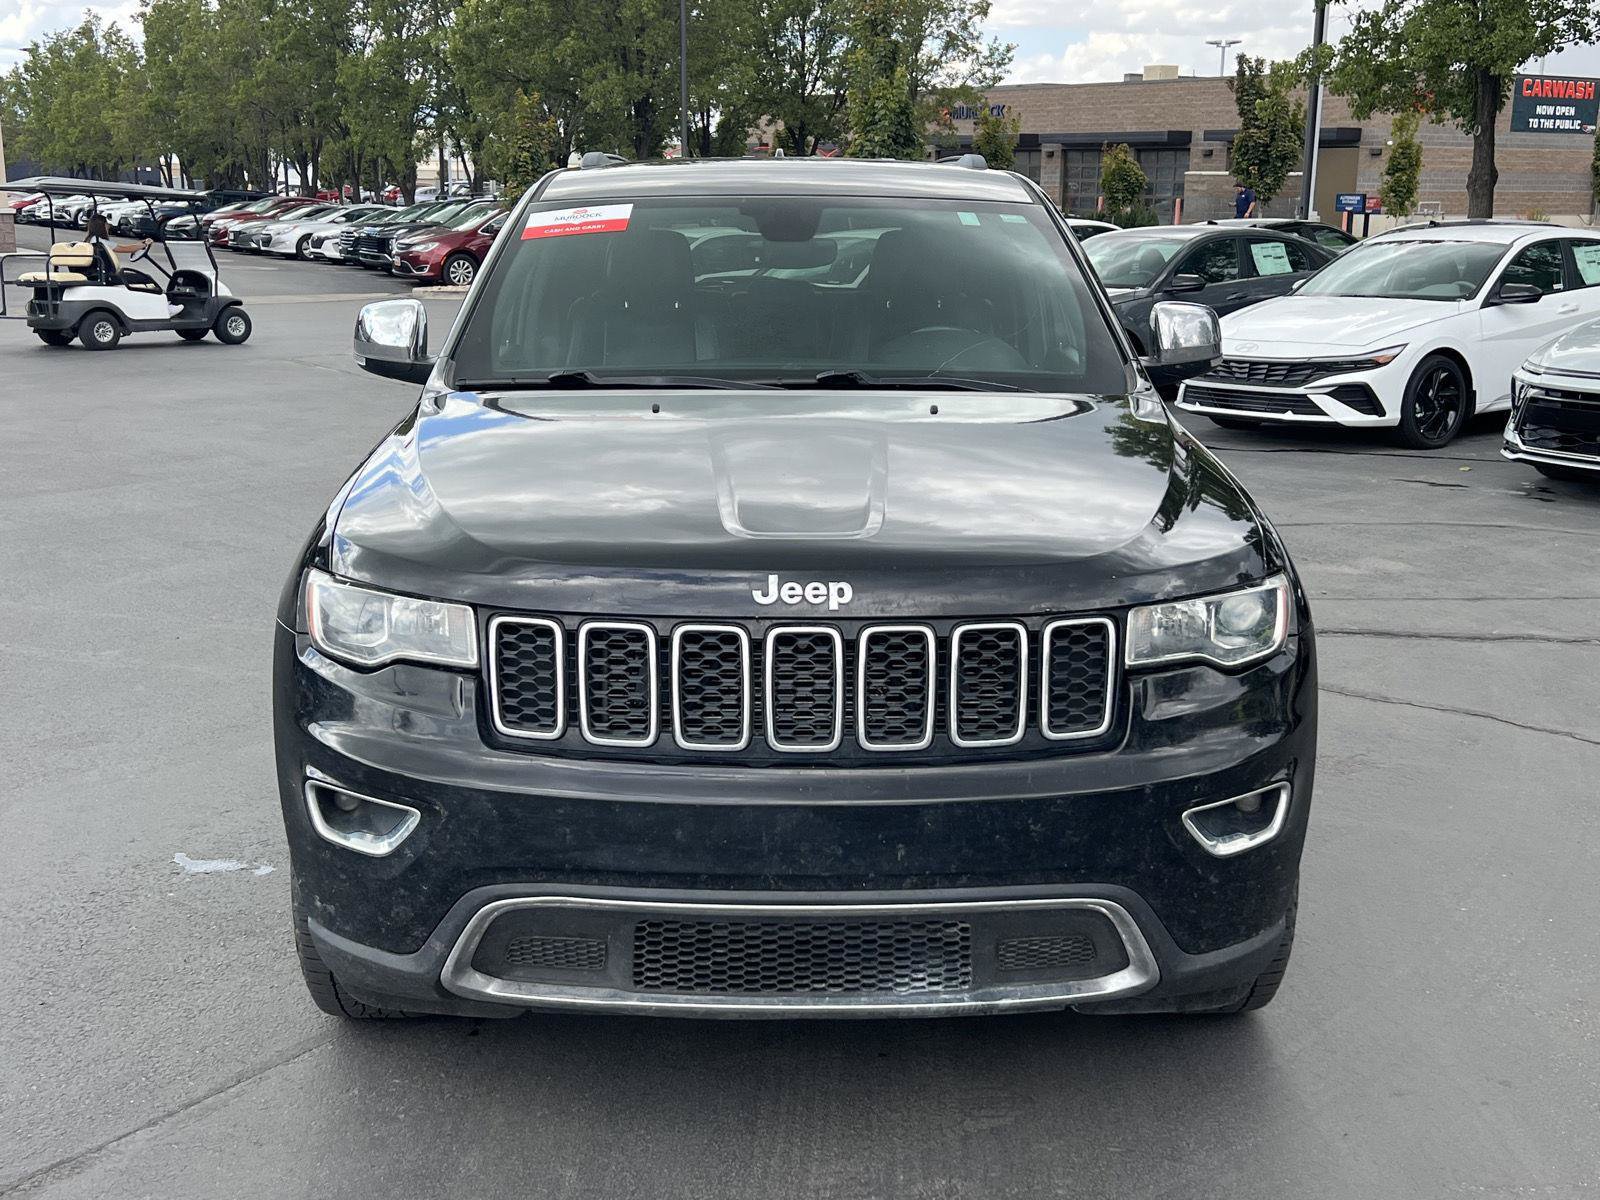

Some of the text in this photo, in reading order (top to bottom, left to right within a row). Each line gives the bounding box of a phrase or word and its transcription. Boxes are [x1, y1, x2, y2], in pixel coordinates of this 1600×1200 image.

[1522, 78, 1595, 99] CARWASH
[951, 104, 1006, 120] MURCK
[1536, 105, 1575, 116] NOW OPEN
[1528, 118, 1581, 129] TO THE PUBLIC
[751, 574, 853, 611] Jeep
